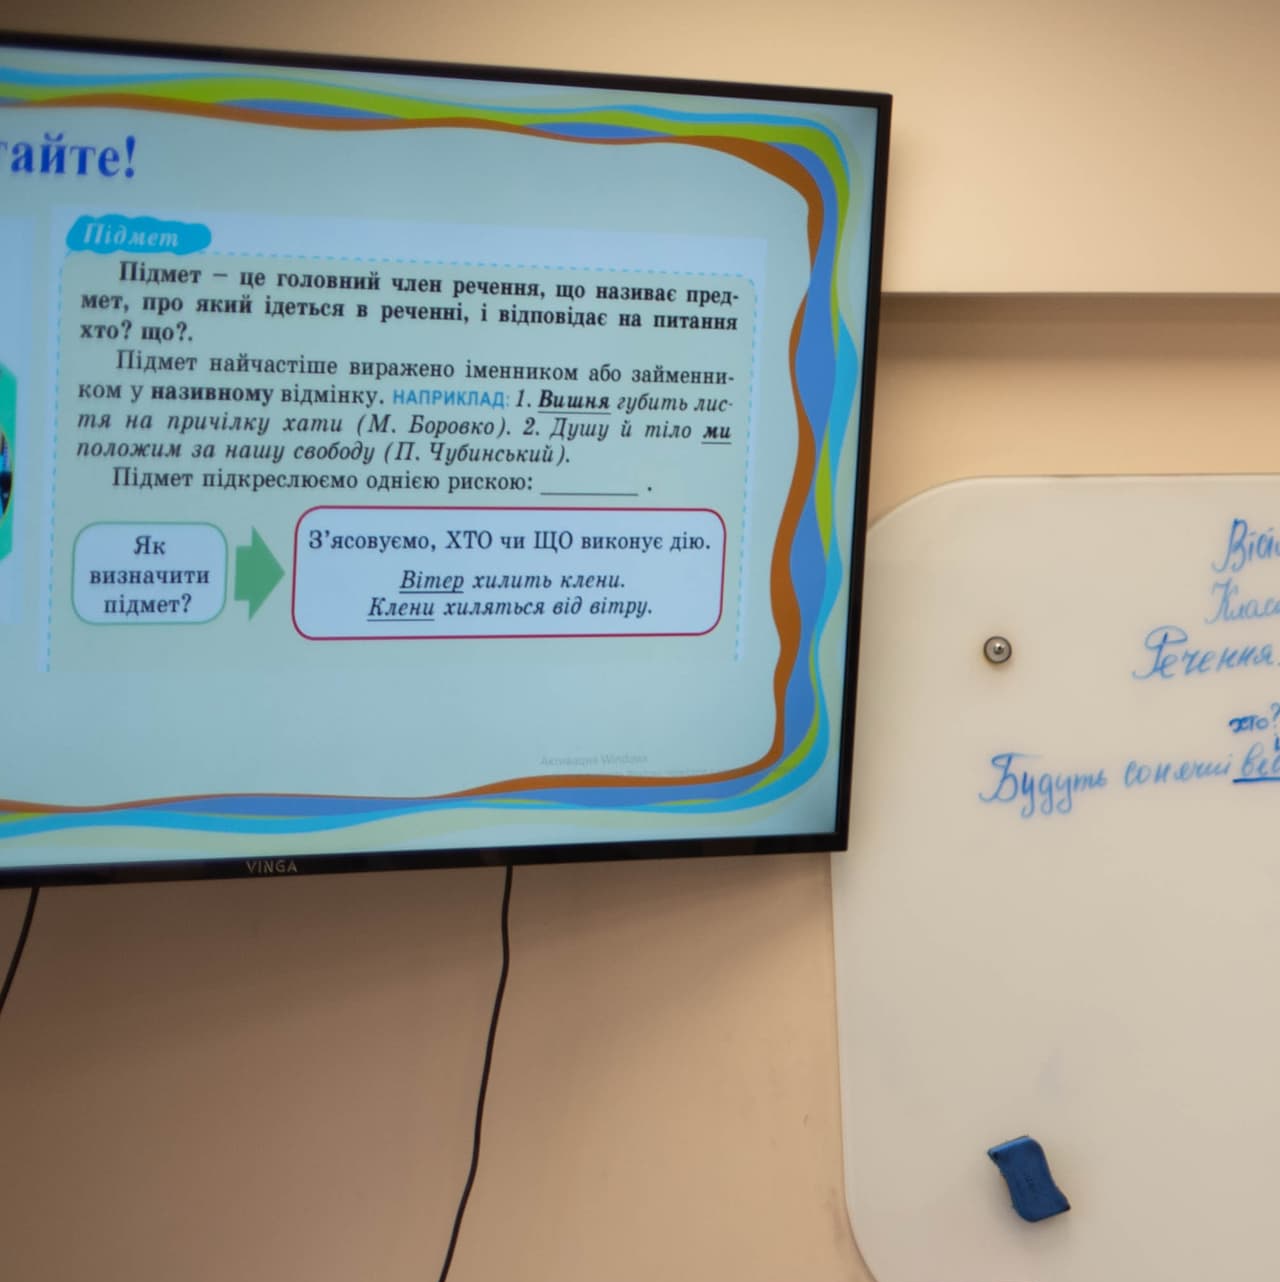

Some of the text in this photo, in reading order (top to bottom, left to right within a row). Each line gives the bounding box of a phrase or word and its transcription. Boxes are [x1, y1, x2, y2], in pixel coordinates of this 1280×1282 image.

[83, 223, 180, 247] Підмет
[118, 260, 203, 286] Підмет
[239, 271, 267, 290] це
[276, 270, 381, 291] головний
[390, 276, 443, 294] член
[451, 279, 546, 301] речення,
[554, 283, 587, 302] що
[594, 284, 678, 303] називає
[685, 288, 740, 308] пред-
[80, 293, 739, 331] мет, про який ідеться в реченні, і відповідає на питання
[79, 318, 193, 345] хто? що?.
[115, 348, 735, 385] Підмет найчастіше виражено іменником або займенни-
[77, 382, 733, 416] ком у називному відмінку. НАПРИКЛАД: 1. Вишня губить лис-
[76, 411, 732, 443] тя на причілку хати (М. Боровко). 2. Душу й тіло ми
[76, 439, 571, 467] положим за нашу свободу (П. Чубинський).
[111, 465, 535, 495] Підмет підкреслюємо однією рискою:
[132, 534, 166, 556] Як
[308, 528, 712, 554] З’ясовуємо, ХТО чи ЩО виконує дію.
[88, 569, 210, 585] визначити
[398, 569, 625, 591] Вітер хилить клени.
[103, 592, 193, 617] підмет?
[367, 594, 653, 620] Клени хиляться від вітру.
[978, 752, 1107, 818] Будуть
[246, 860, 298, 873] VINGA
